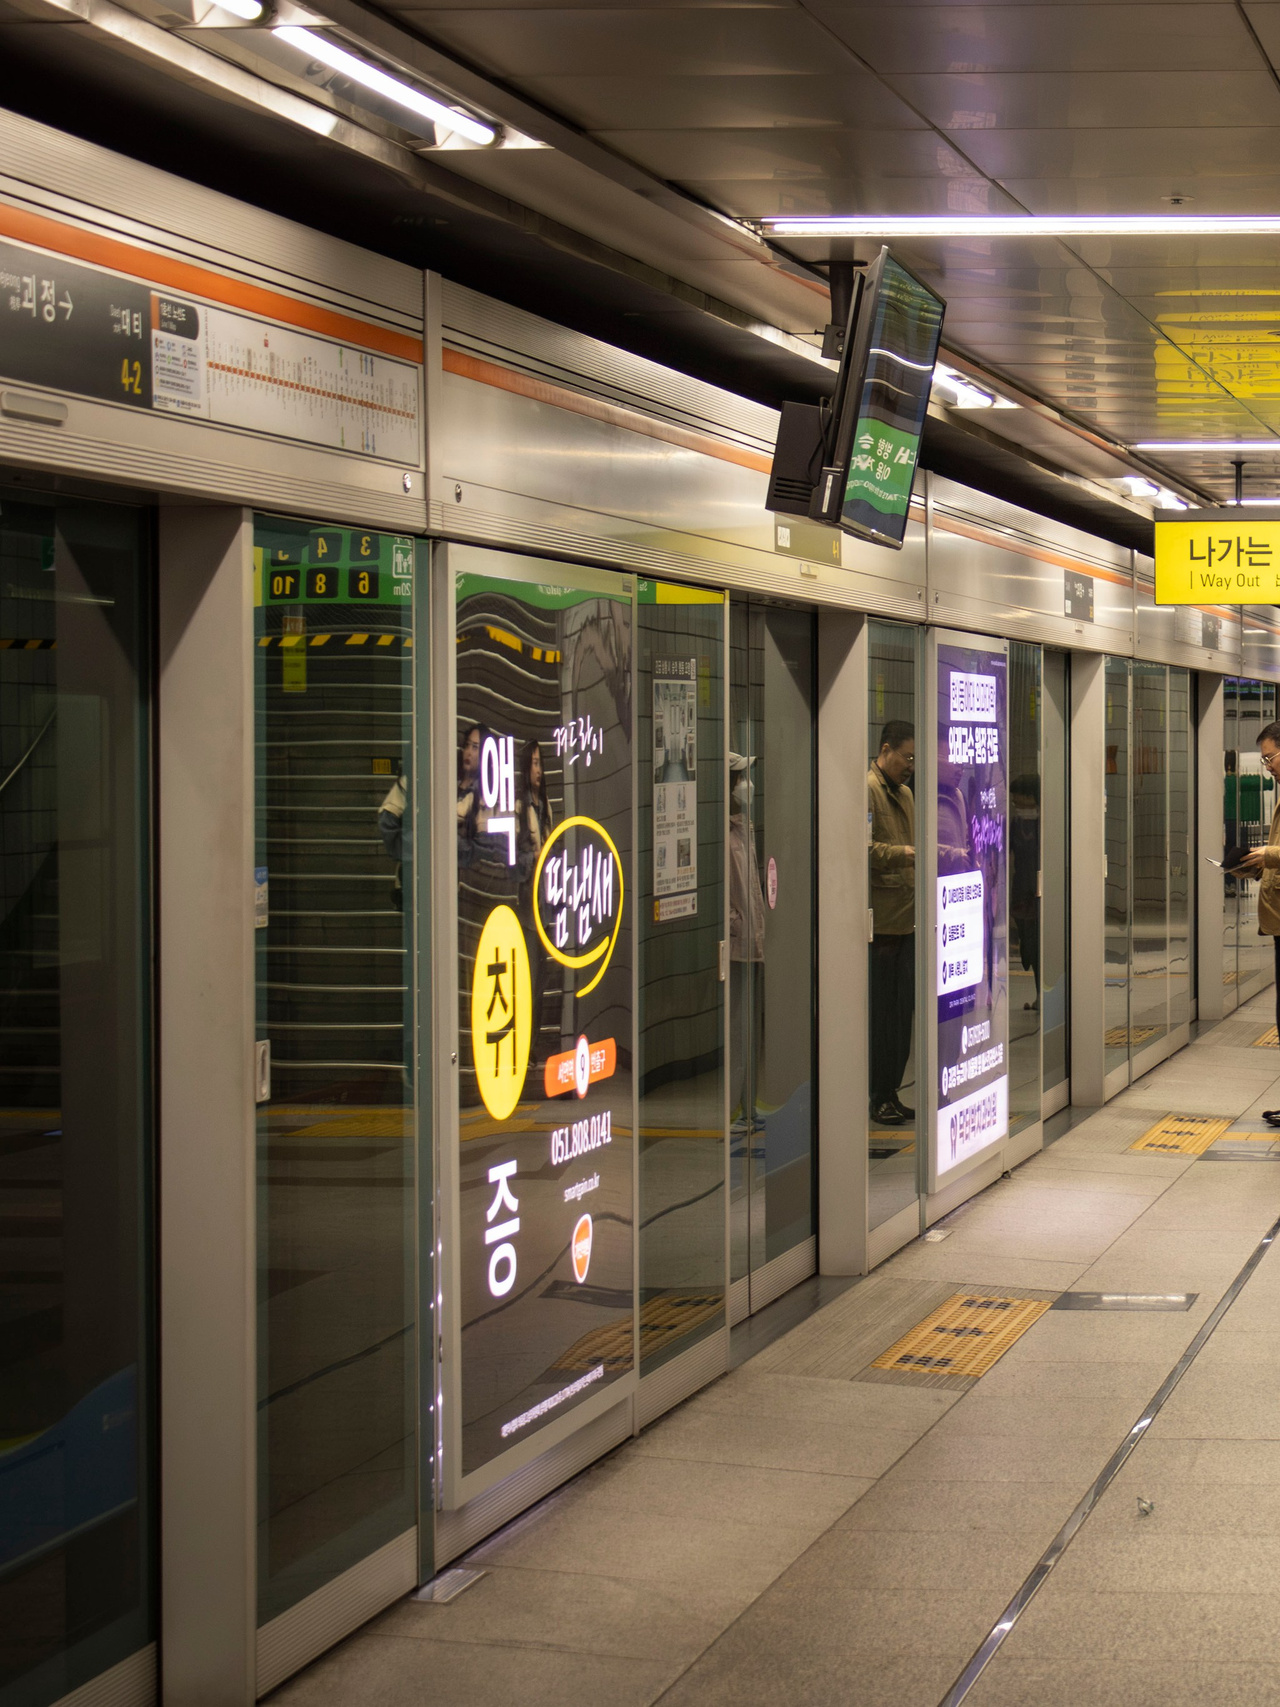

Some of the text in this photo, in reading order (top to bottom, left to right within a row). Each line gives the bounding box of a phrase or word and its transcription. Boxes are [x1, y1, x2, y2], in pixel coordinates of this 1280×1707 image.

[22, 274, 56, 322] 괴정
[121, 308, 142, 340] 대티
[121, 358, 142, 394] 4-2
[1189, 536, 1273, 567] 나가는
[1200, 573, 1260, 589] Way Out
[580, 1053, 586, 1080] 9
[551, 1110, 612, 1165] 051.808.0141
